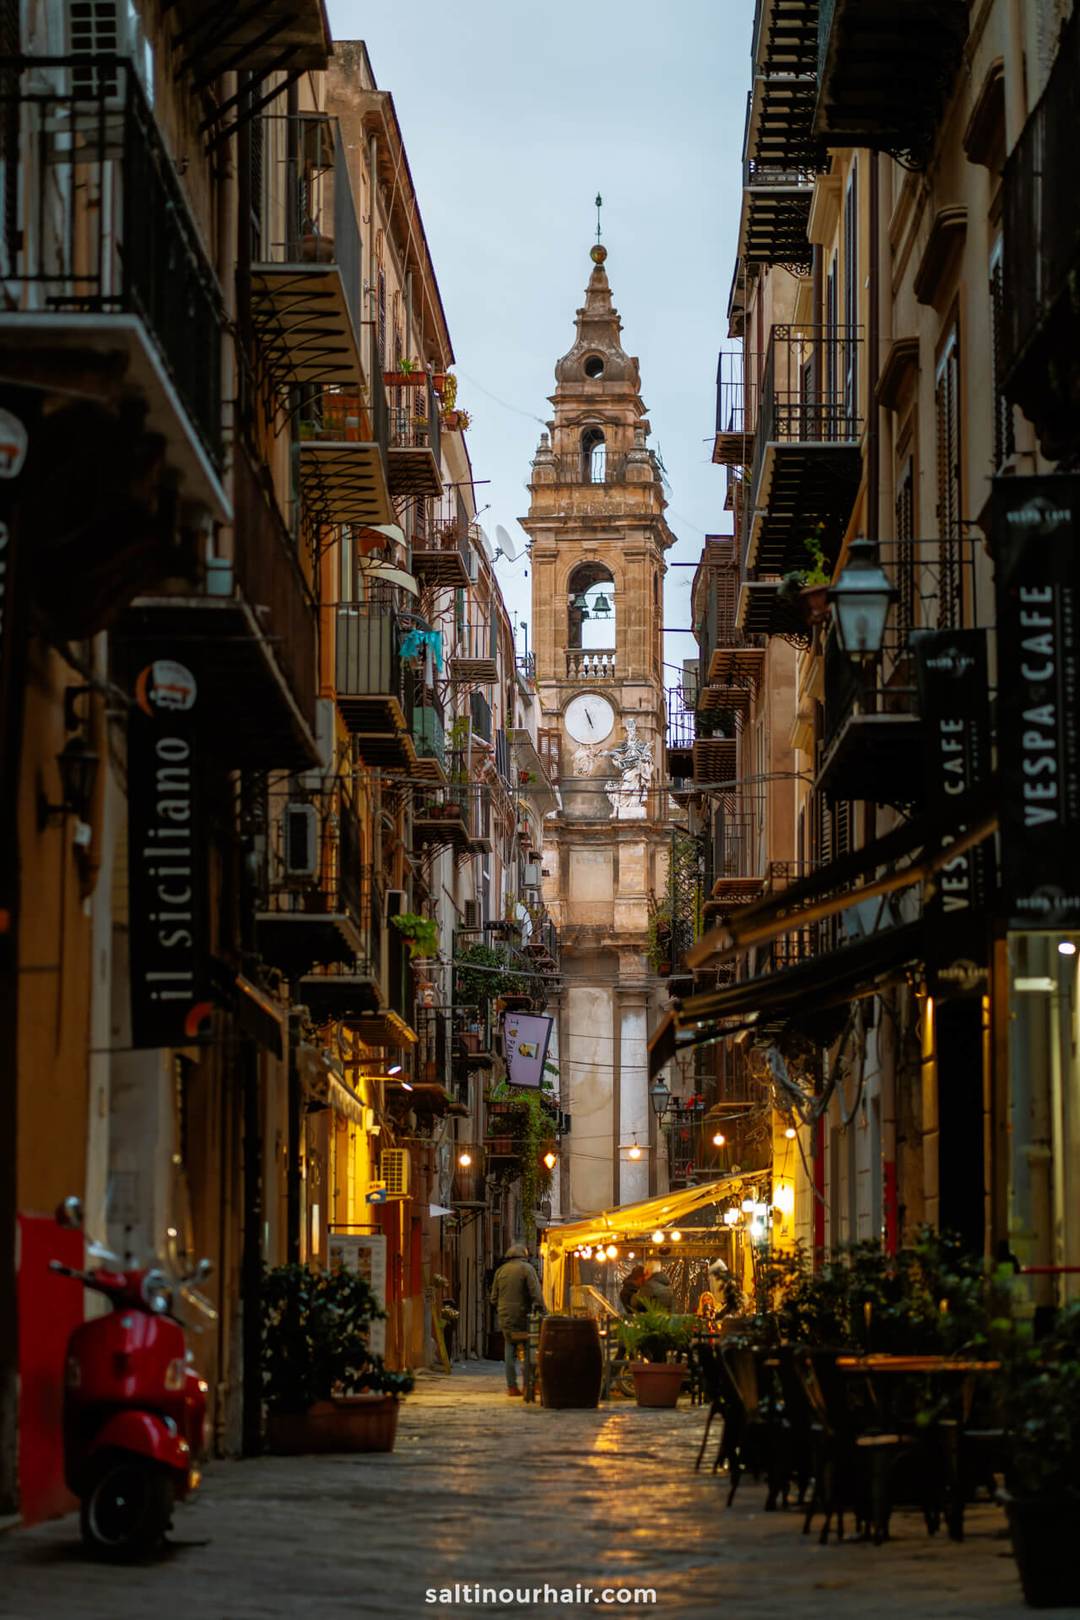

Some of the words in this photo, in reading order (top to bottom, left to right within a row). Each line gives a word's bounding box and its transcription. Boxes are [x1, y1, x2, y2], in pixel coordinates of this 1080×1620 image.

[1021, 585, 1054, 680] CAFE
[940, 718, 965, 795] CAFE
[1022, 704, 1058, 826] VESPA
[143, 736, 193, 948] siciliano
[941, 824, 969, 912] VES
[145, 970, 193, 1001] il
